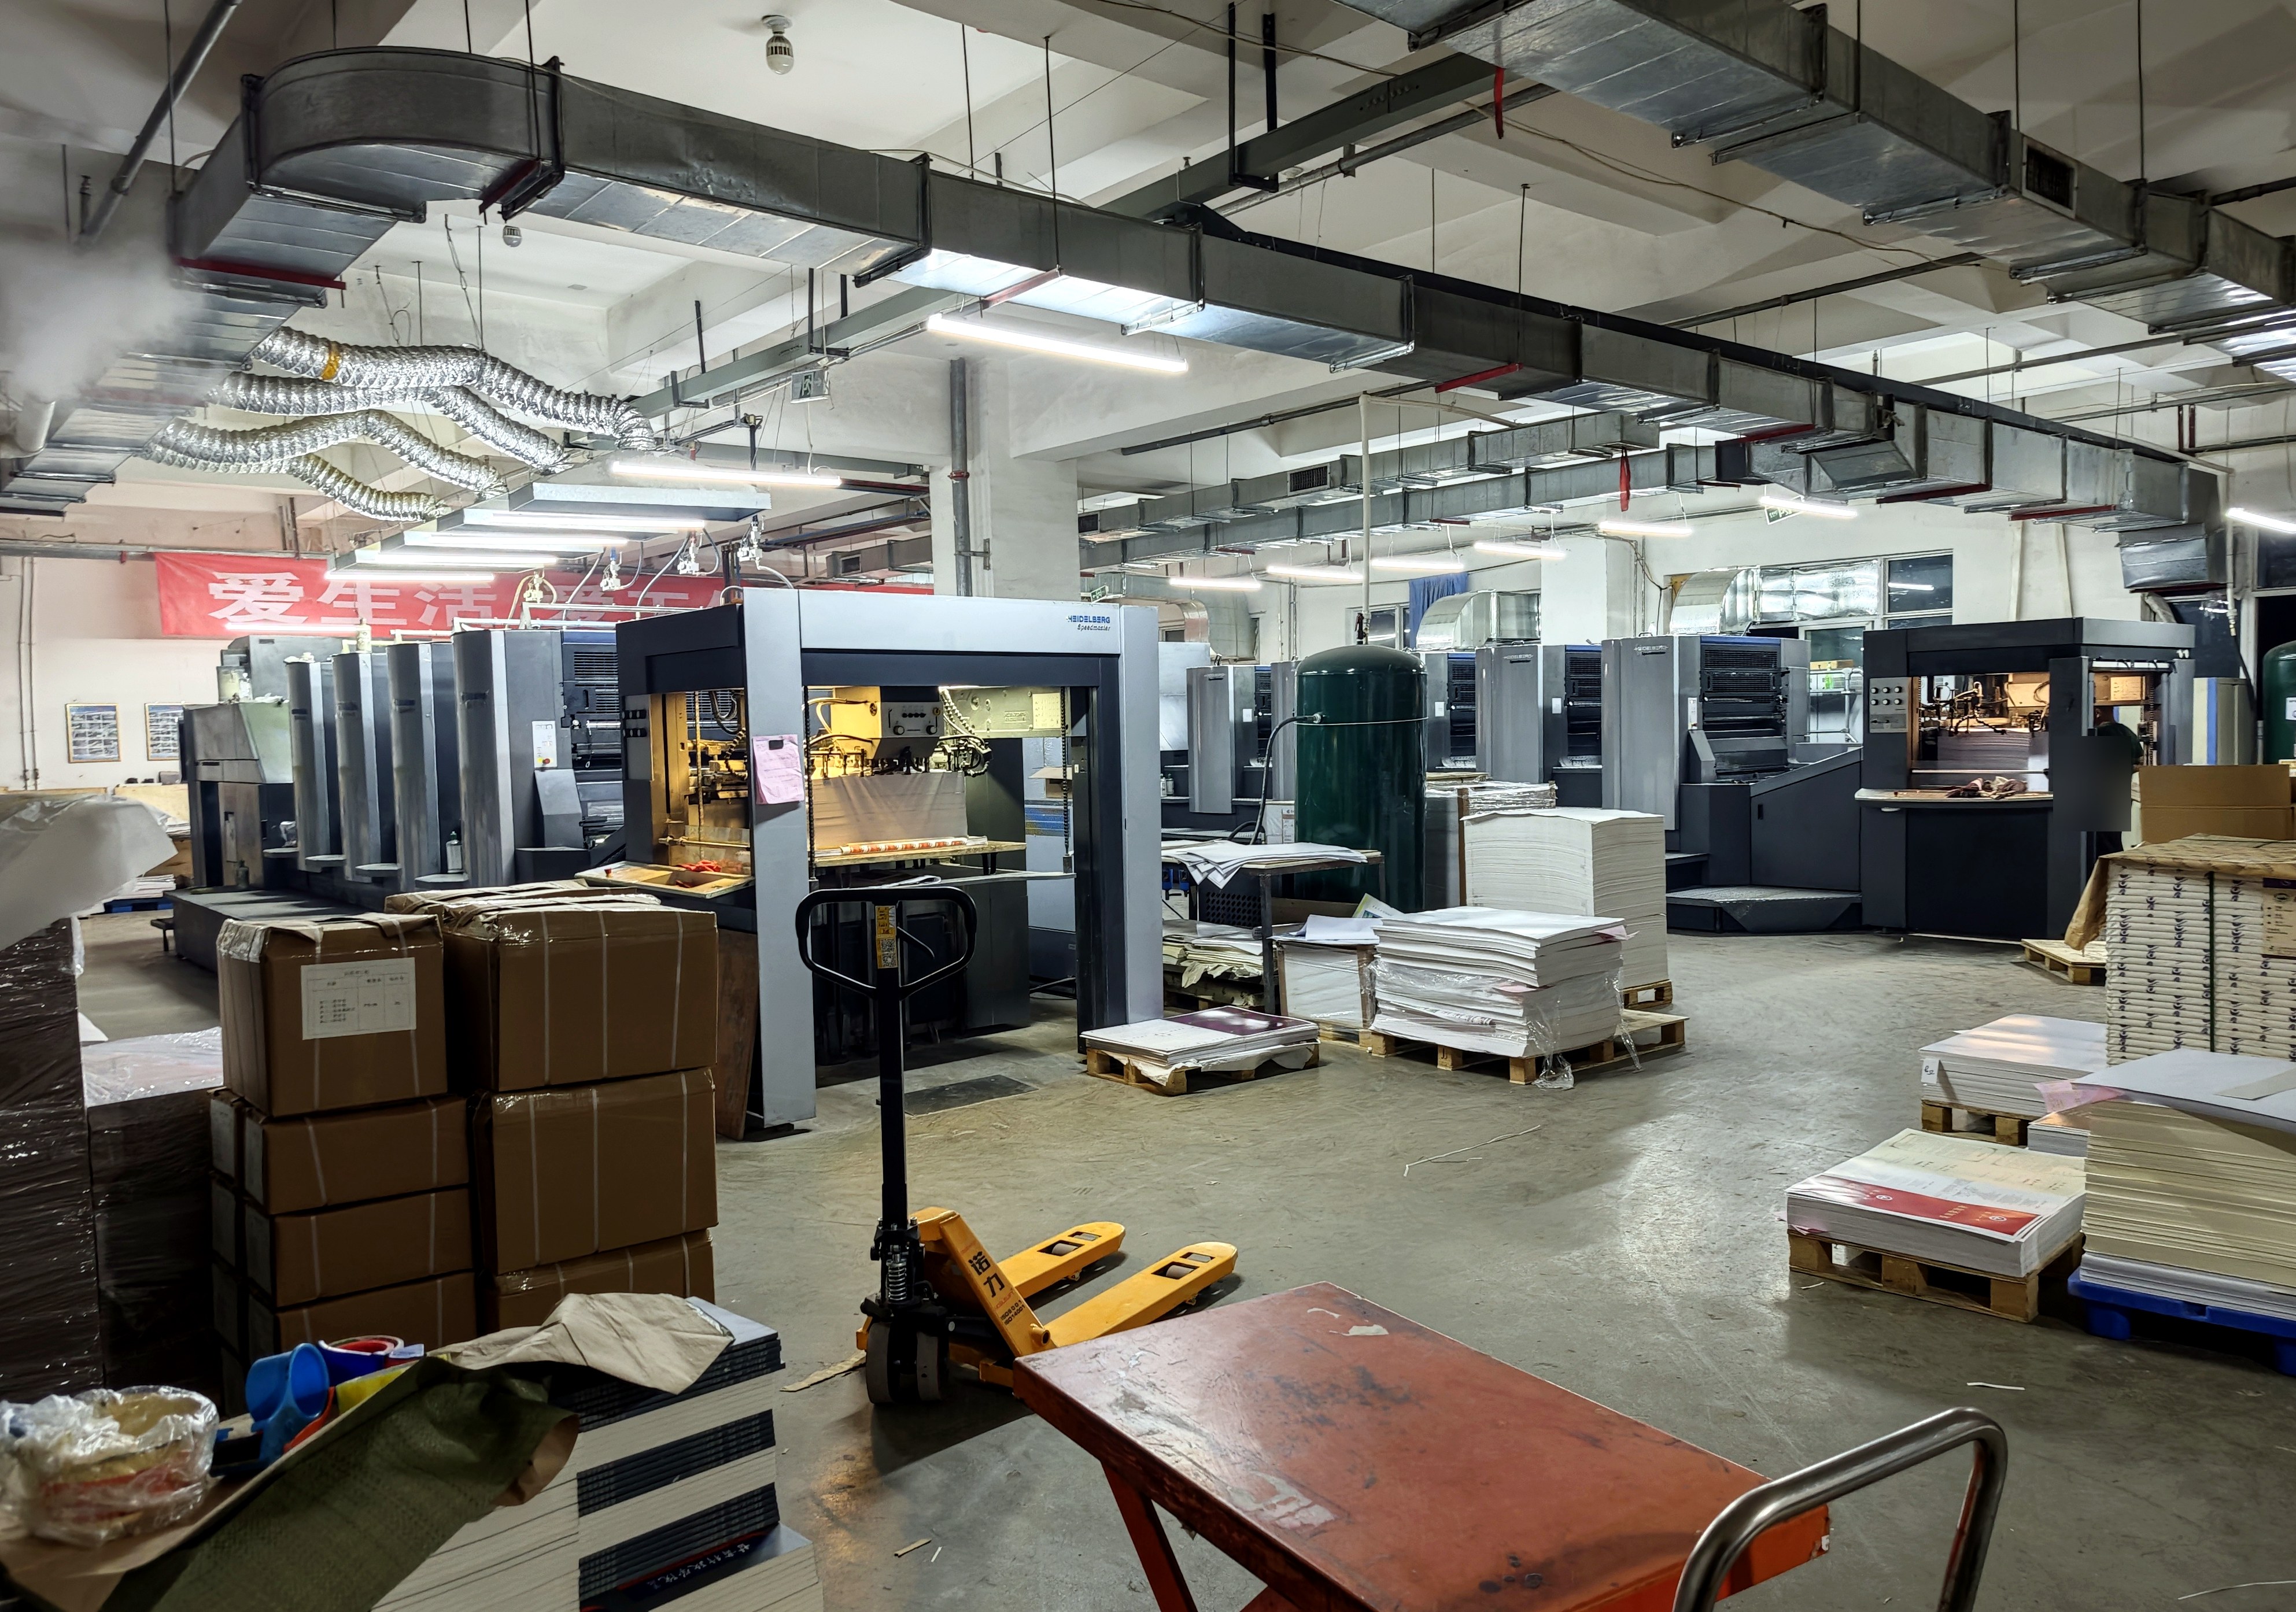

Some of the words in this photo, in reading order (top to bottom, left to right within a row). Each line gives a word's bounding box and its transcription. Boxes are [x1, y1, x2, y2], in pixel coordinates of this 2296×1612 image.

[209, 571, 497, 627] 爱生活
[1066, 615, 1110, 624] HEIDELBERG
[968, 1251, 1005, 1298] 诺力
